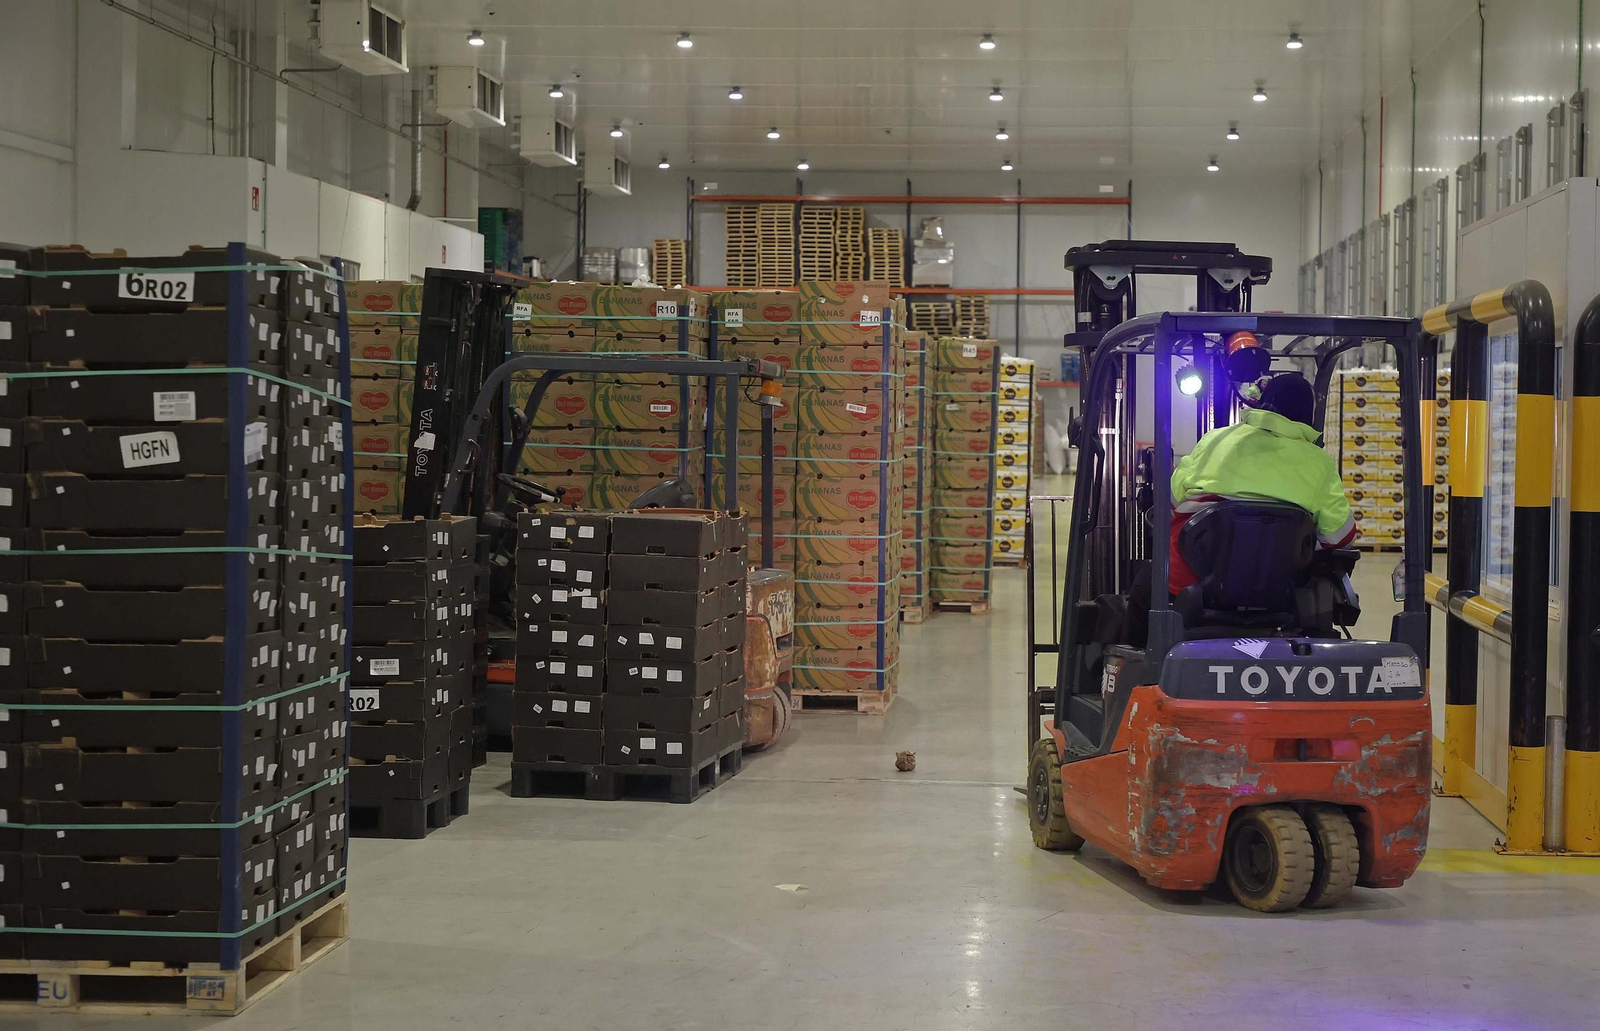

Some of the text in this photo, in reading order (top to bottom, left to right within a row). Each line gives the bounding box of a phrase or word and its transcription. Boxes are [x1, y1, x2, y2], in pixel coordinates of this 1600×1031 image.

[126, 272, 187, 300] 6R02
[657, 306, 676, 314] R10
[131, 439, 170, 461] HGFN
[415, 408, 433, 477] TOYTA
[1208, 665, 1394, 695] TOYOTA
[37, 980, 68, 1000] EU
